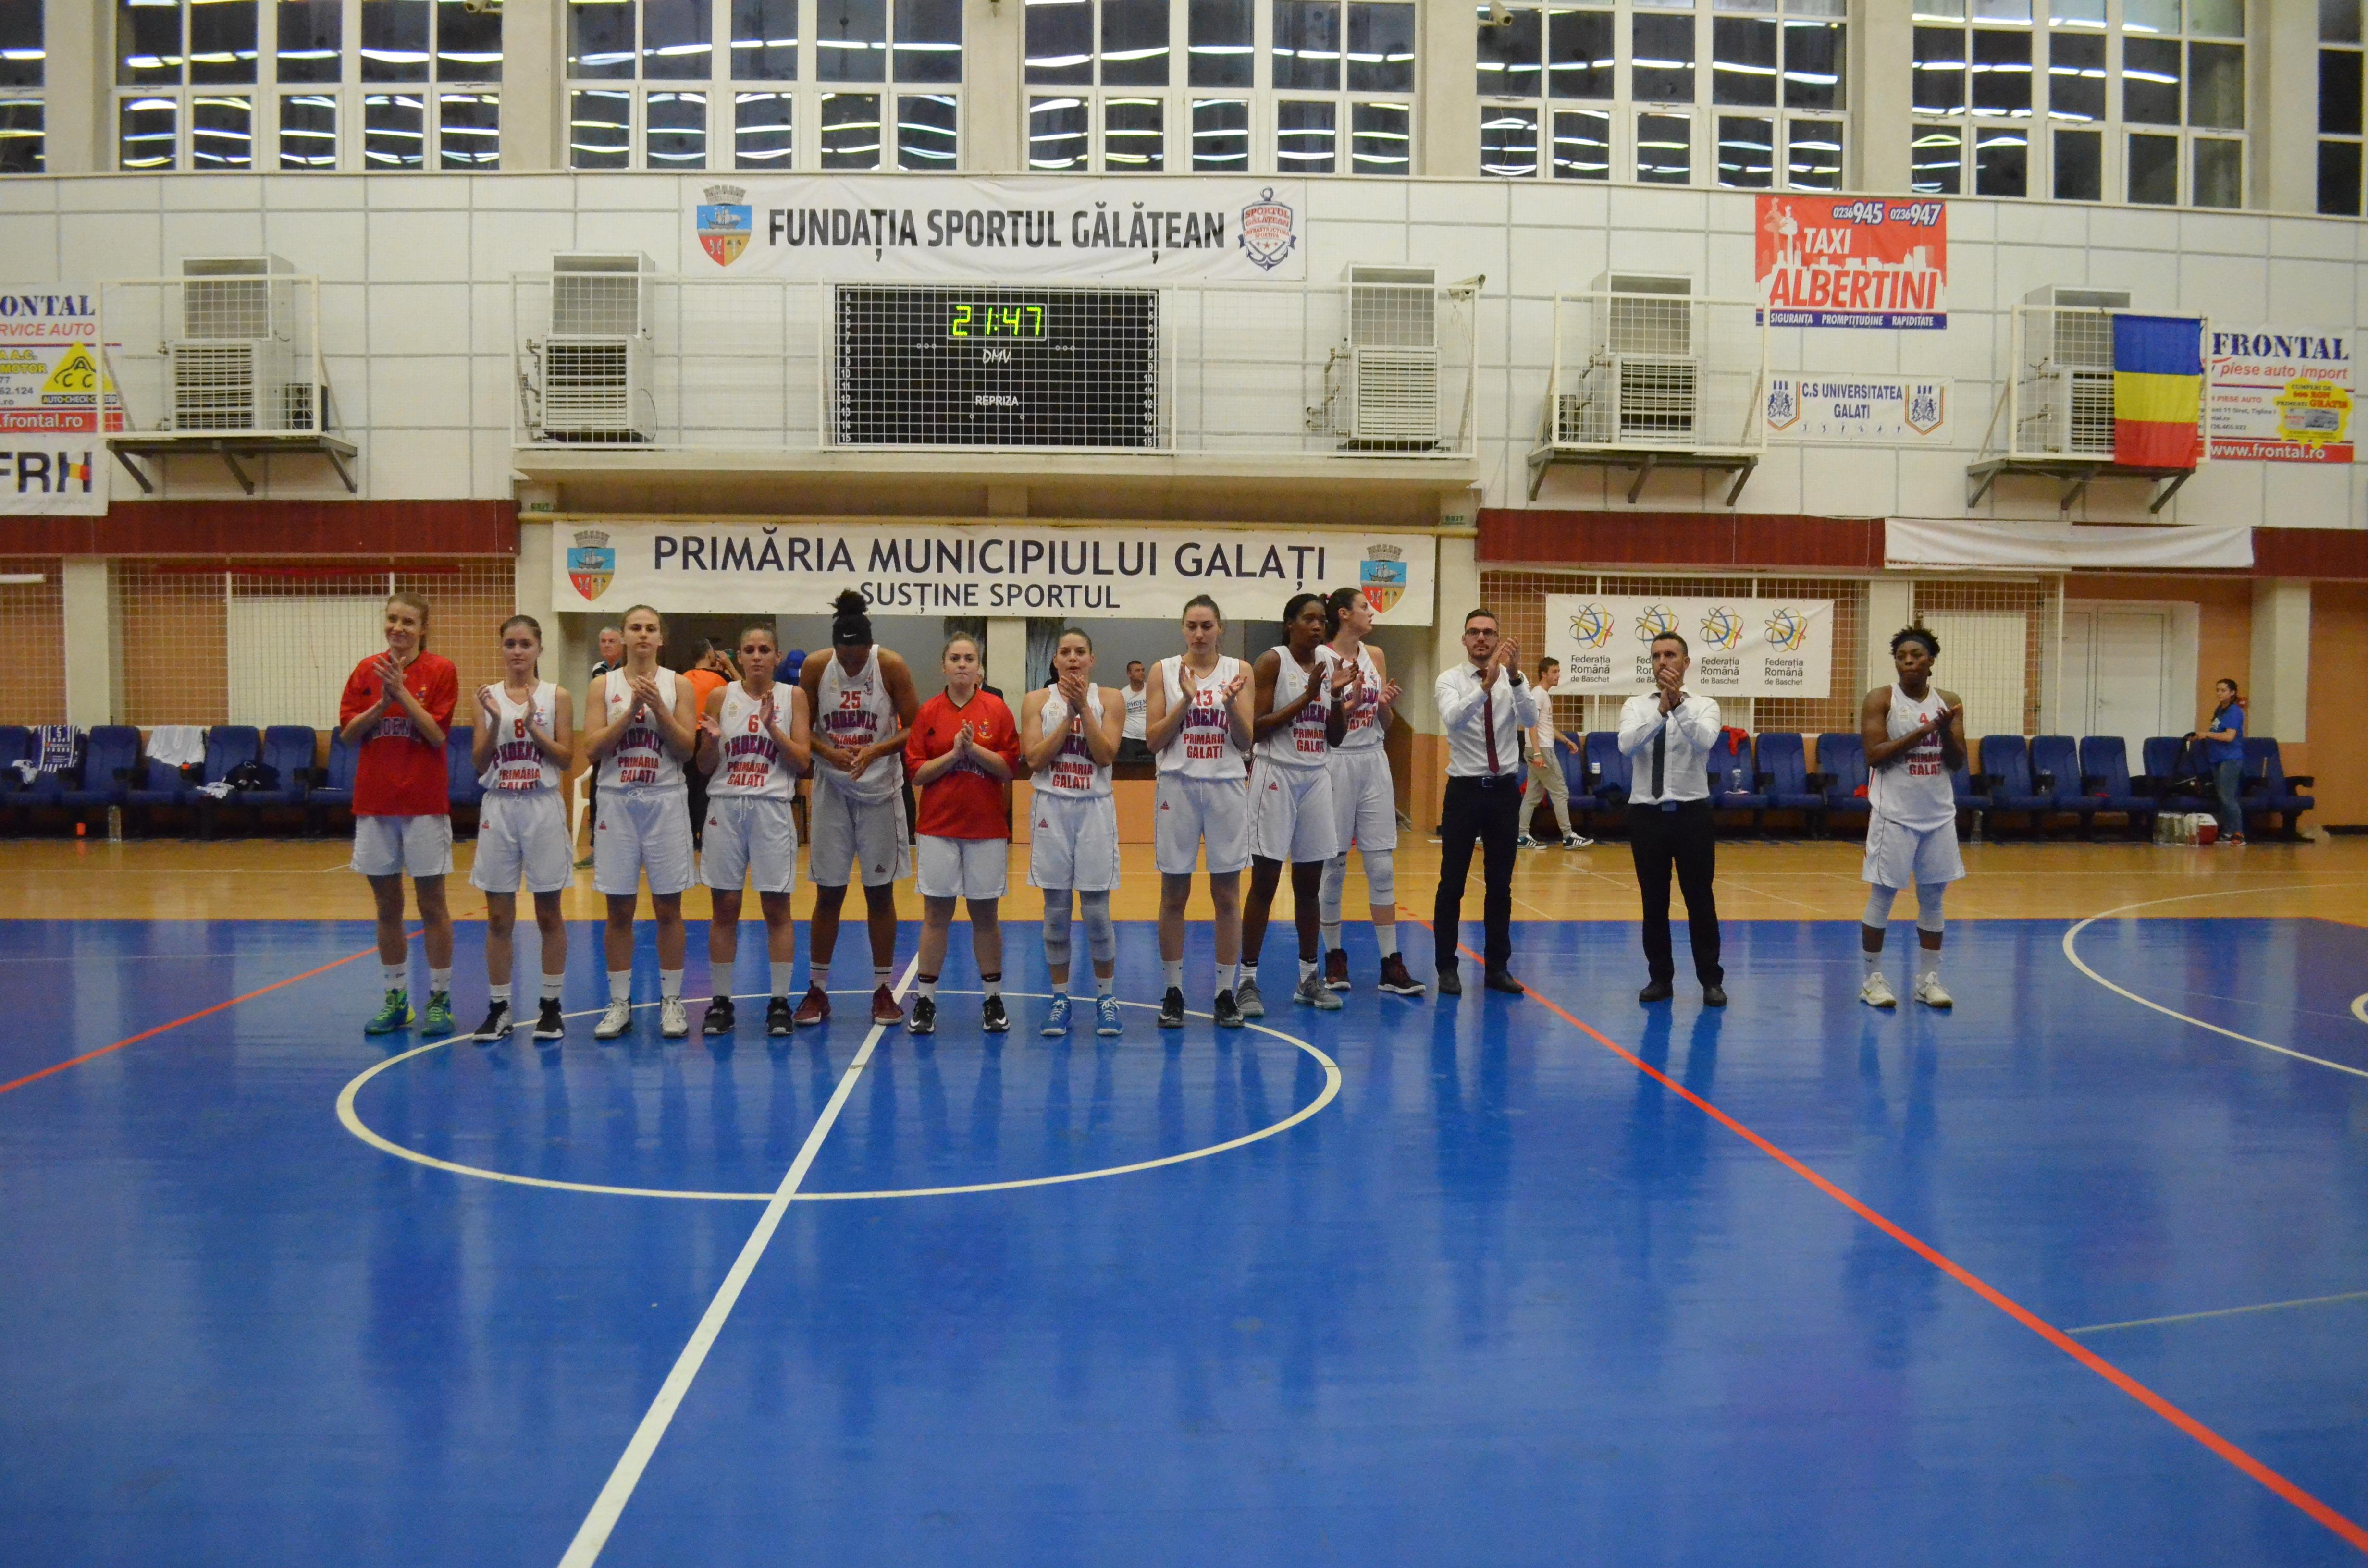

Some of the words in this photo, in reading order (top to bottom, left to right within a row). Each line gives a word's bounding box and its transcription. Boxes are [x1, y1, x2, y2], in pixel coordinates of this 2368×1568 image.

[769, 209, 918, 262] FUNDAȚIA
[927, 209, 1061, 247] SPORTUL
[1072, 201, 1224, 264] GĂLĂȚEAN
[1804, 228, 1851, 254] TAXI
[1769, 268, 1938, 309] ALBERTINI
[953, 306, 1041, 335] 21:47
[1822, 314, 1883, 326] PROMPTITUDINE
[1892, 315, 1933, 326] RAPIDITATE
[50, 323, 95, 336] AUTO
[2212, 333, 2349, 360] FRONTAL
[841, 369, 851, 378] 10
[2220, 362, 2260, 377] piese
[2265, 365, 2296, 377] auto
[2300, 365, 2348, 380] import
[1144, 374, 1153, 383] 10
[842, 381, 850, 391] 11
[1144, 387, 1152, 396] 11
[1822, 383, 1903, 400] UNIVERSITATEA
[841, 394, 851, 404] 12
[975, 395, 1019, 406] REPRIZA
[1144, 399, 1153, 408] 12
[841, 407, 851, 416] 13
[1144, 412, 1153, 421] 13
[1834, 403, 1870, 419] GALATI
[841, 420, 851, 429] 14
[1144, 425, 1152, 434] 14
[841, 433, 851, 442] 15
[1144, 438, 1152, 446] 15
[654, 527, 855, 573] PRIMĂRIA
[868, 539, 1156, 576] MUNICIPIULUI
[1174, 542, 1325, 591] GALAȚI
[860, 582, 978, 614] SUSȚINE
[990, 582, 1120, 609] SPORTUL
[1571, 655, 1610, 665] Federația
[1702, 657, 1739, 666] Federația
[1765, 658, 1803, 668] Federația
[1571, 664, 1610, 674] Română
[839, 690, 861, 709] 25
[1196, 690, 1213, 707] 13
[515, 719, 525, 738] 8
[748, 715, 759, 733] 6
[1184, 732, 1225, 744] PRIMĂRIA
[618, 755, 658, 769] PRIMĂRIA
[1050, 760, 1093, 775] PRIMĂRIA
